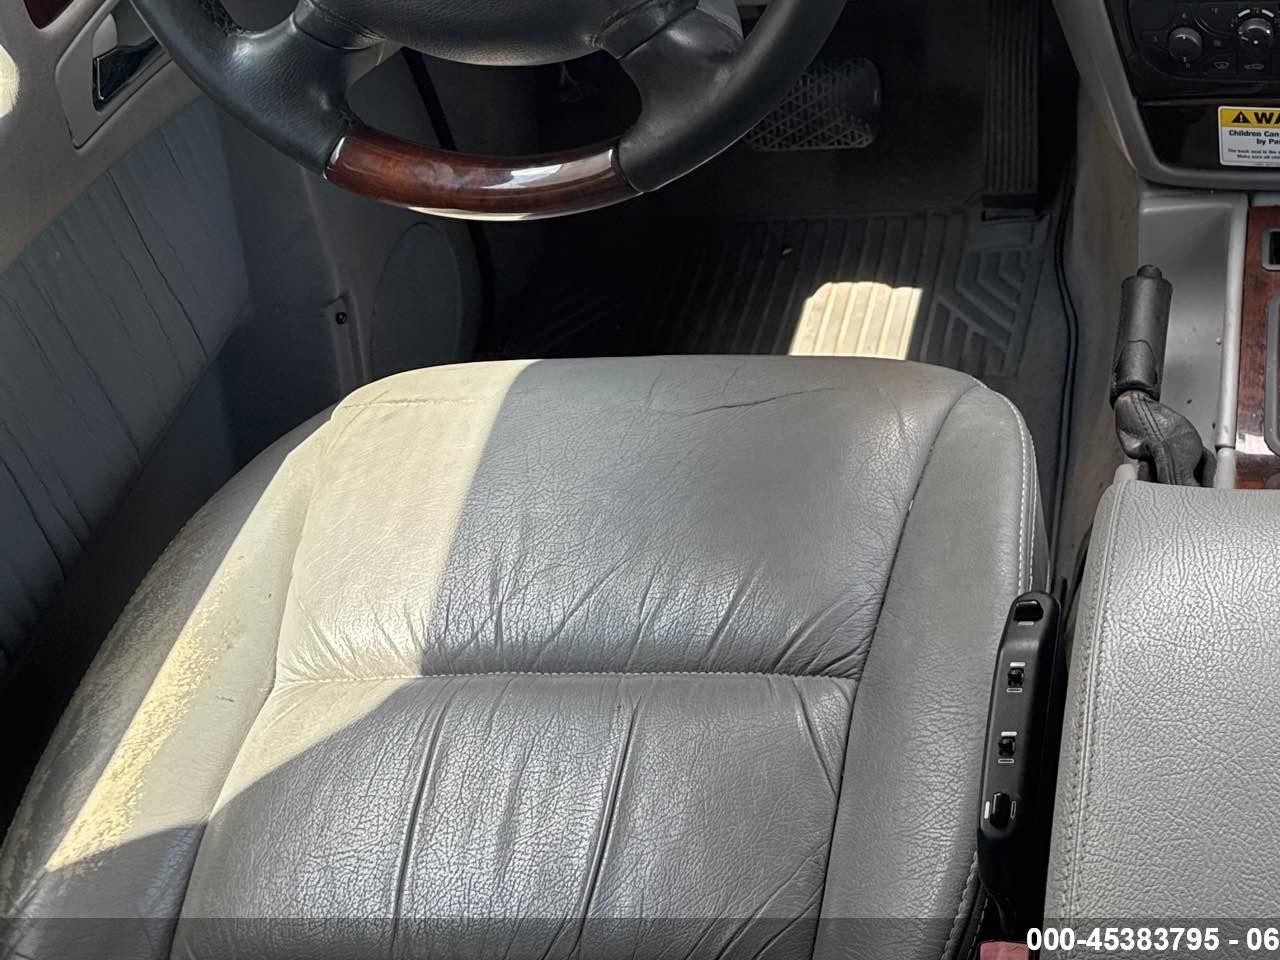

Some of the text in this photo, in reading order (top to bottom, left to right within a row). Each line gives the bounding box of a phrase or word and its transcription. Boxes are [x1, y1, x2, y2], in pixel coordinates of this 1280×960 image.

[1228, 129, 1262, 137] Children
[1263, 130, 1279, 138] Can
[1256, 138, 1267, 147] by
